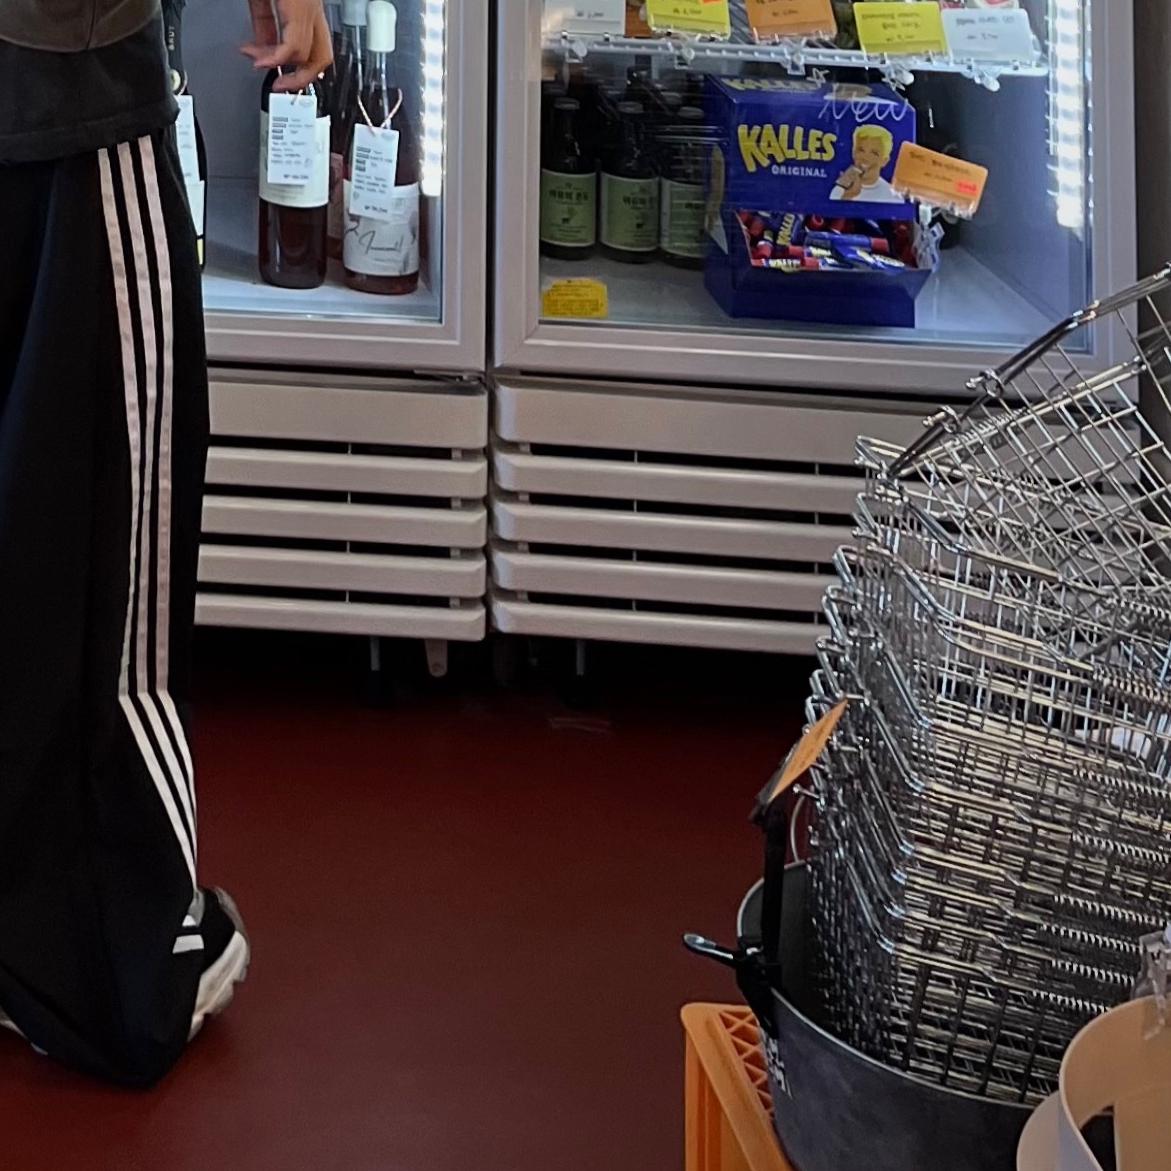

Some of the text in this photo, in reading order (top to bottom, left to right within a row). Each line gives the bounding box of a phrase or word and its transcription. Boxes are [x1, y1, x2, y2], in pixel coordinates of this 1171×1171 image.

[818, 80, 909, 122] New
[737, 123, 837, 173] KALLES
[771, 163, 827, 178] ORIGINAL
